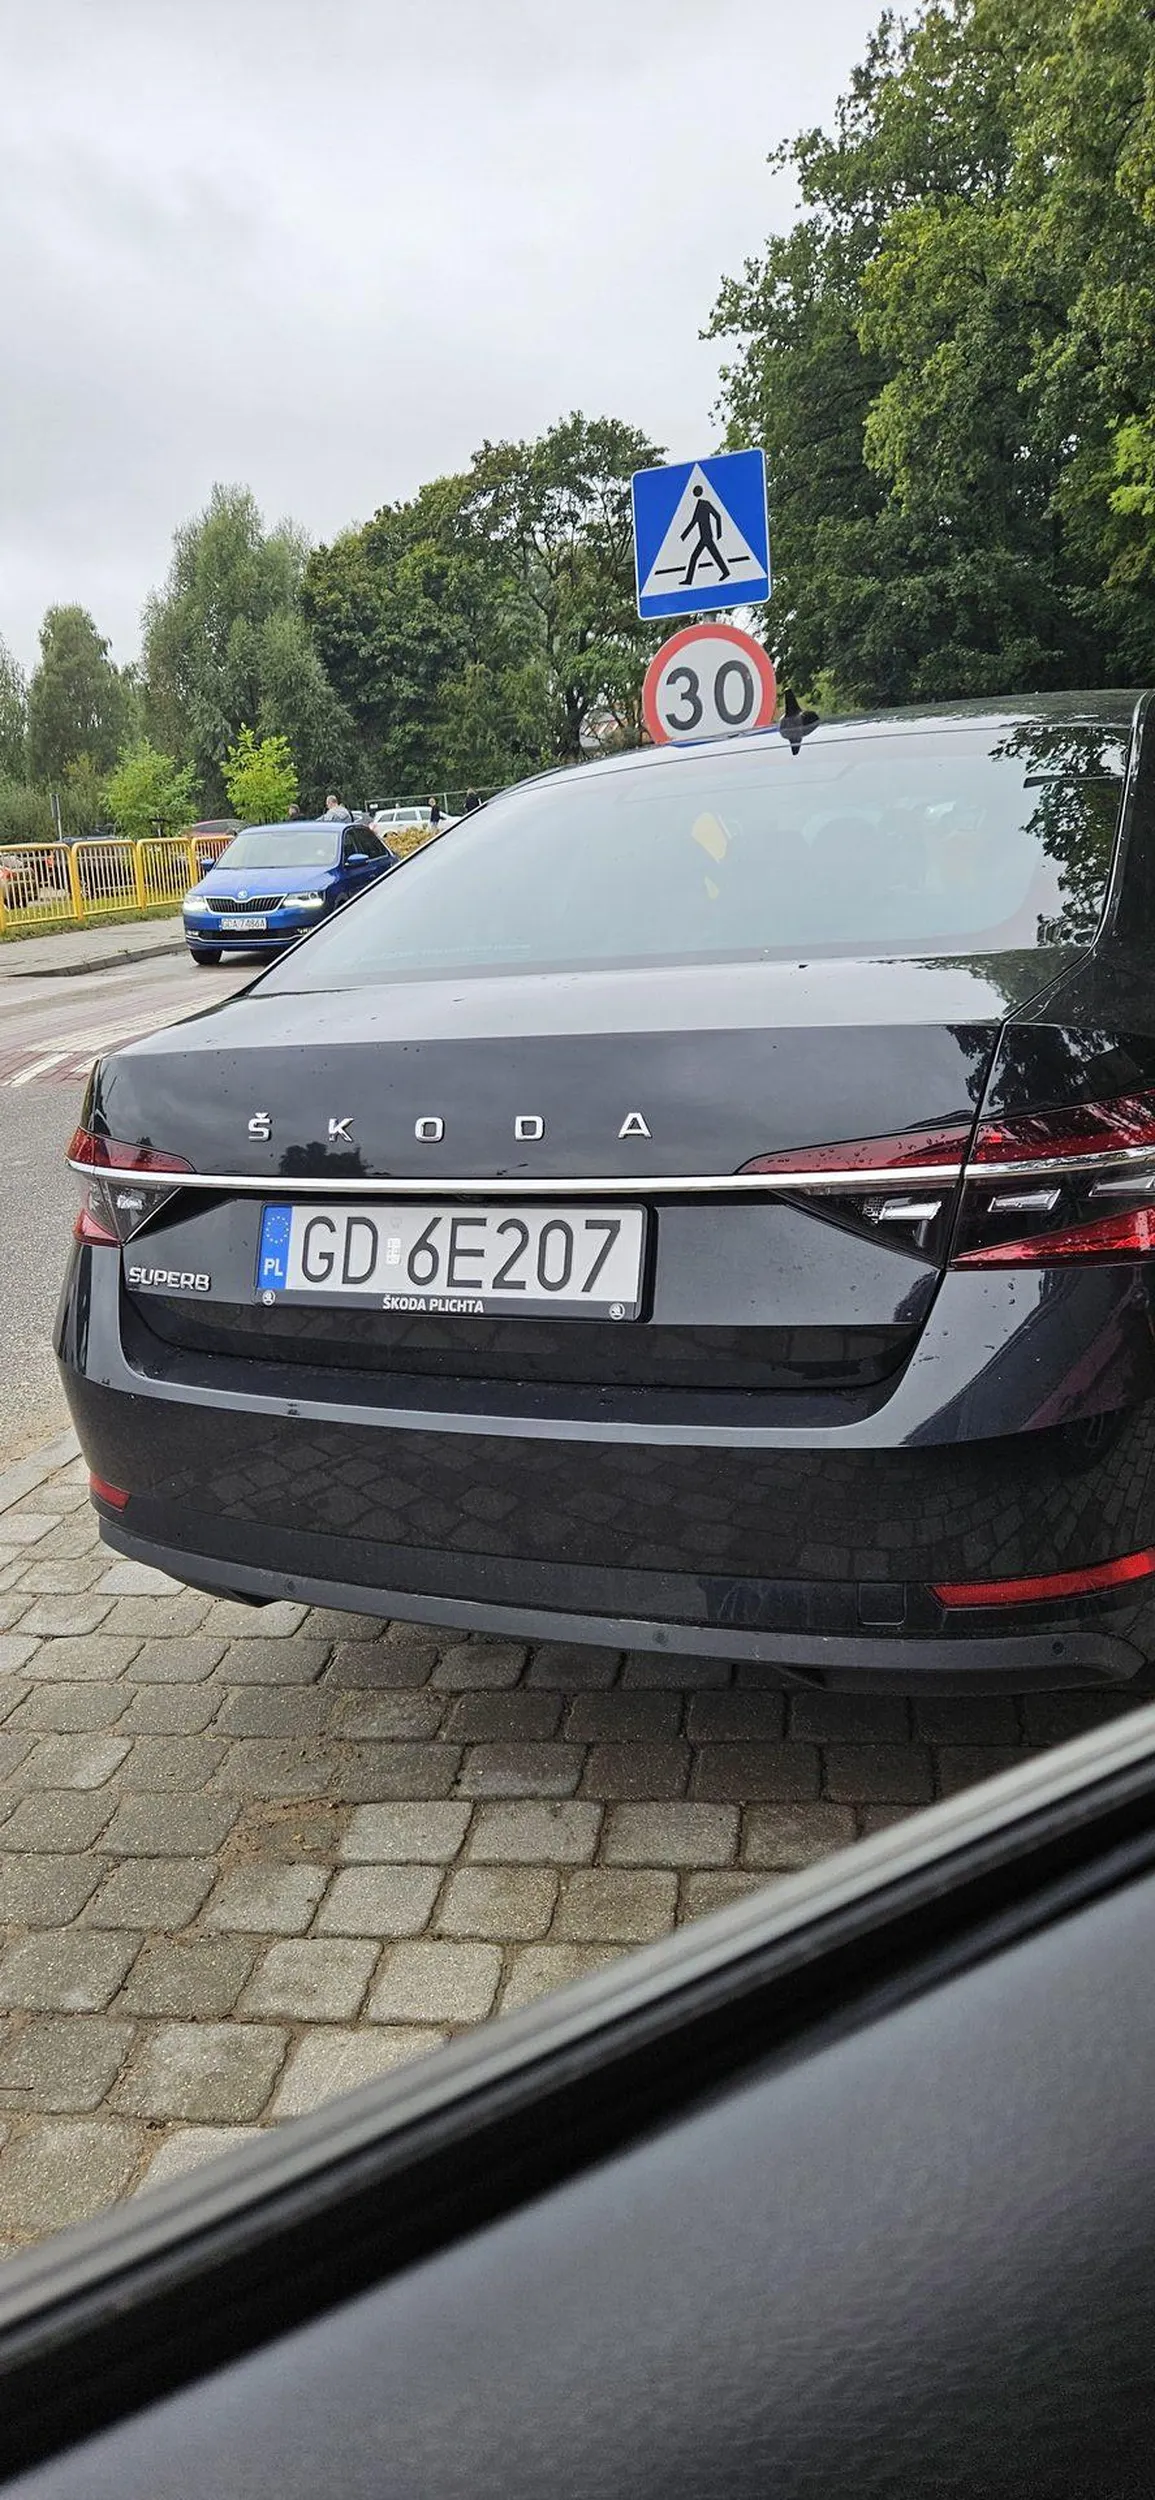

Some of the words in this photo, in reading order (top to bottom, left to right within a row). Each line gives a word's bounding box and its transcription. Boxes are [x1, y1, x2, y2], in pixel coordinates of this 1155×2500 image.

[665, 660, 755, 731] 30
[247, 1112, 652, 1142] ŠKODA
[264, 1257, 283, 1276] PL
[301, 1215, 379, 1285] GD
[407, 1217, 622, 1293] 6E207
[128, 1266, 211, 1291] SUPERB
[382, 1294, 426, 1311] ŠKODA
[429, 1298, 484, 1313] PLICHTA
